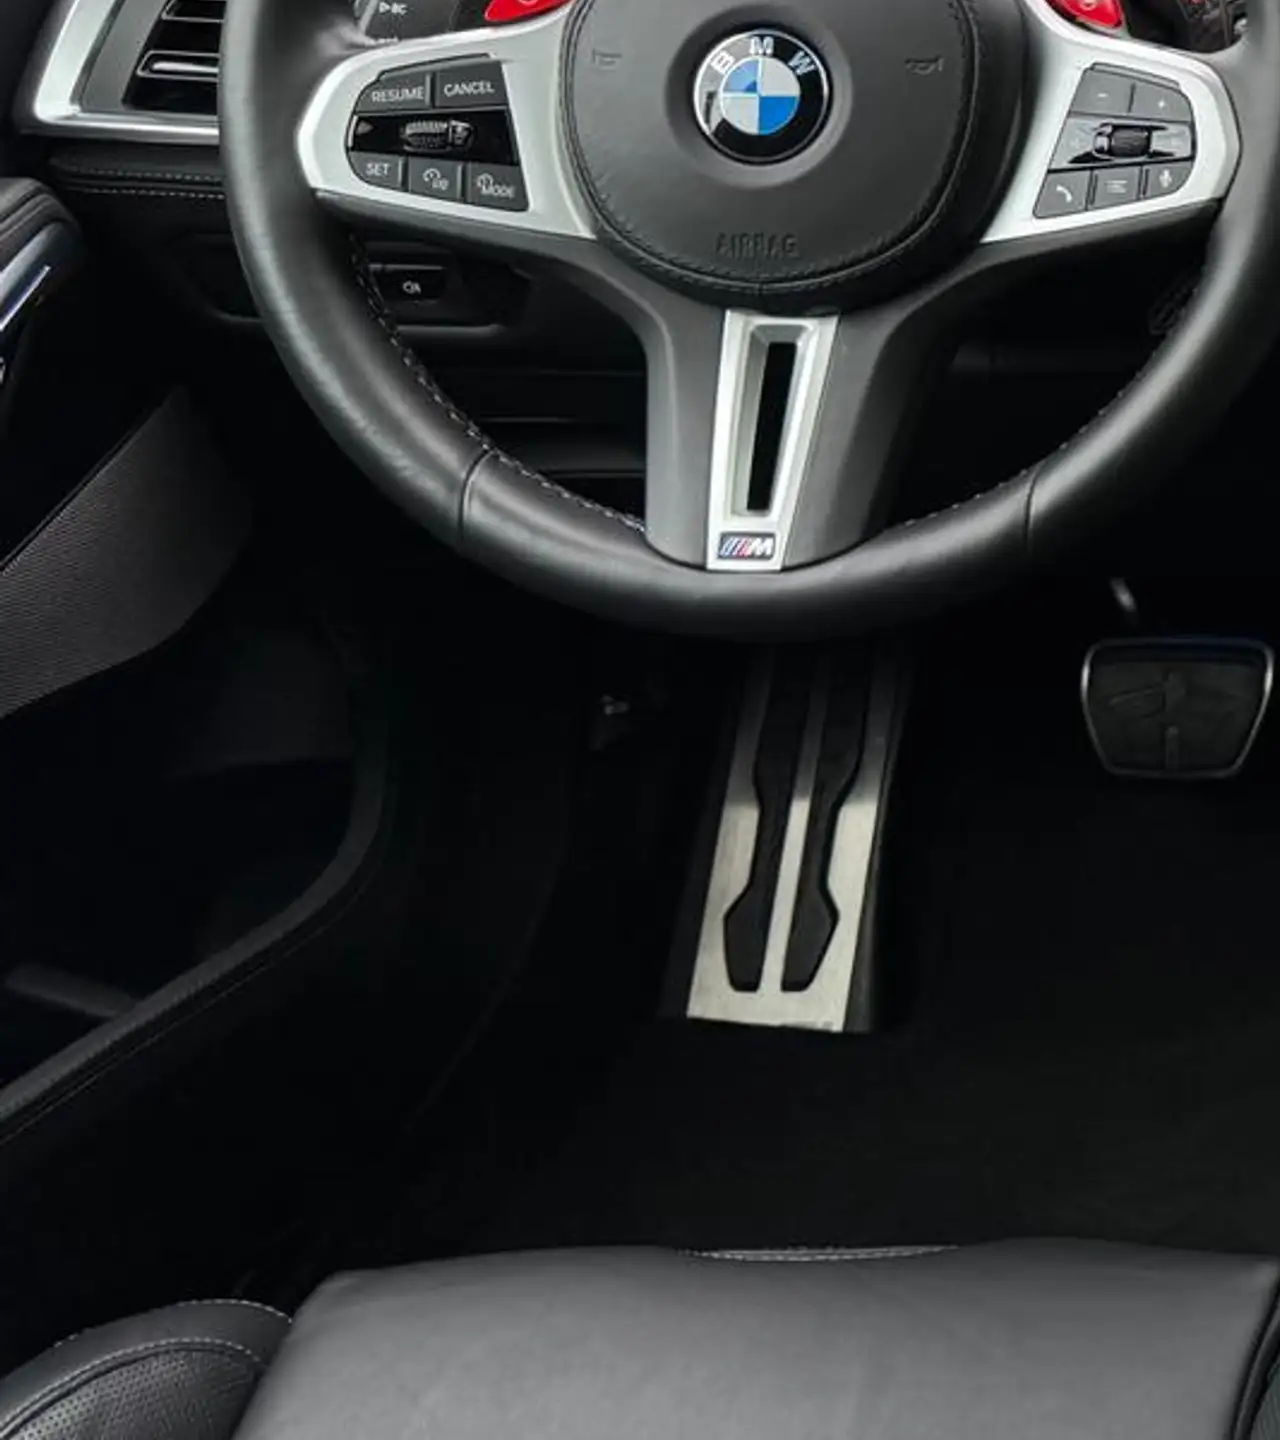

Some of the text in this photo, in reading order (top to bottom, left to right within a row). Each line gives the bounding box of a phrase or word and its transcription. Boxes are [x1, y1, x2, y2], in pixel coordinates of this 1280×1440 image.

[710, 36, 816, 76] BMW
[371, 81, 496, 102] RESUME CANCEL
[366, 162, 391, 177] SET
[480, 182, 517, 199] MODE
[715, 231, 800, 260] AIRBAG
